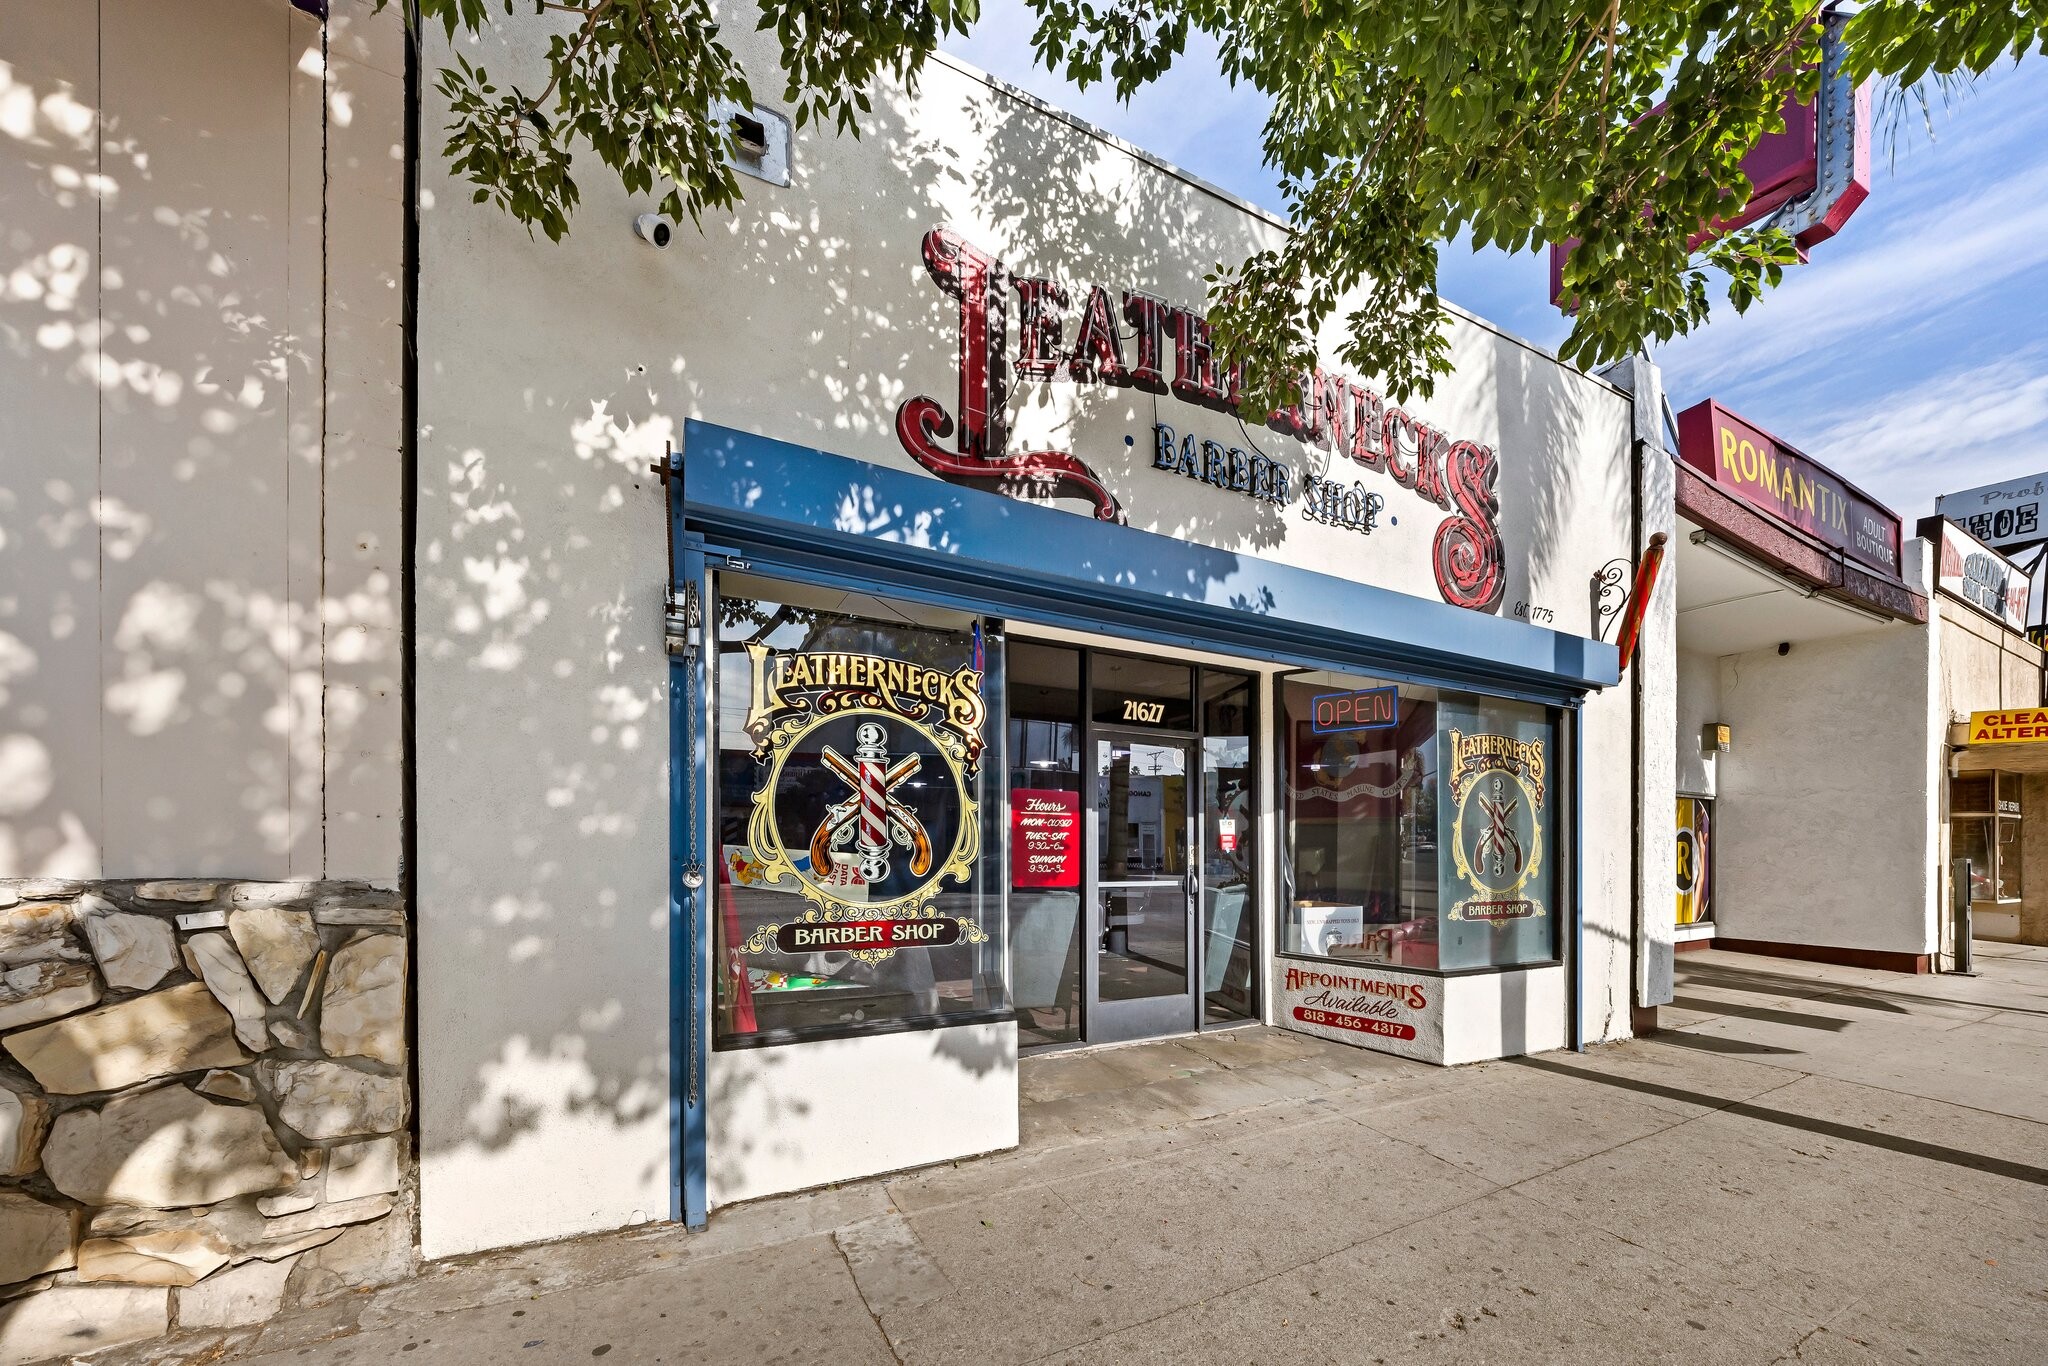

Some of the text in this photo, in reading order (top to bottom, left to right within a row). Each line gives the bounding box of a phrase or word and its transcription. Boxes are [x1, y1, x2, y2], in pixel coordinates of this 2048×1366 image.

[896, 222, 1506, 612] LEATHNECKS
[1151, 422, 1384, 535] BARBER SHOP
[1720, 426, 1848, 536] ROMANTIX
[1863, 516, 1887, 543] ADULT
[1856, 531, 1895, 566] BOUTIQUE
[1532, 606, 1554, 624] 1775
[743, 638, 985, 733] LEATHERNECKS
[1123, 699, 1164, 724] 21627
[1317, 694, 1392, 726] OPEN
[1983, 711, 2048, 727] CLEA
[1975, 726, 2048, 741] ALTER
[1450, 729, 1545, 782] LEATHERNECKS
[1025, 798, 1067, 812] Hours
[1028, 855, 1067, 864] SUNDAY
[1468, 903, 1528, 917] BARBER SHOP
[794, 923, 945, 946] BARBER SHOP
[1284, 967, 1427, 1011] APPOINTMENTS
[1303, 990, 1399, 1019] Available
[1303, 1009, 1403, 1036] 818 456 4317
